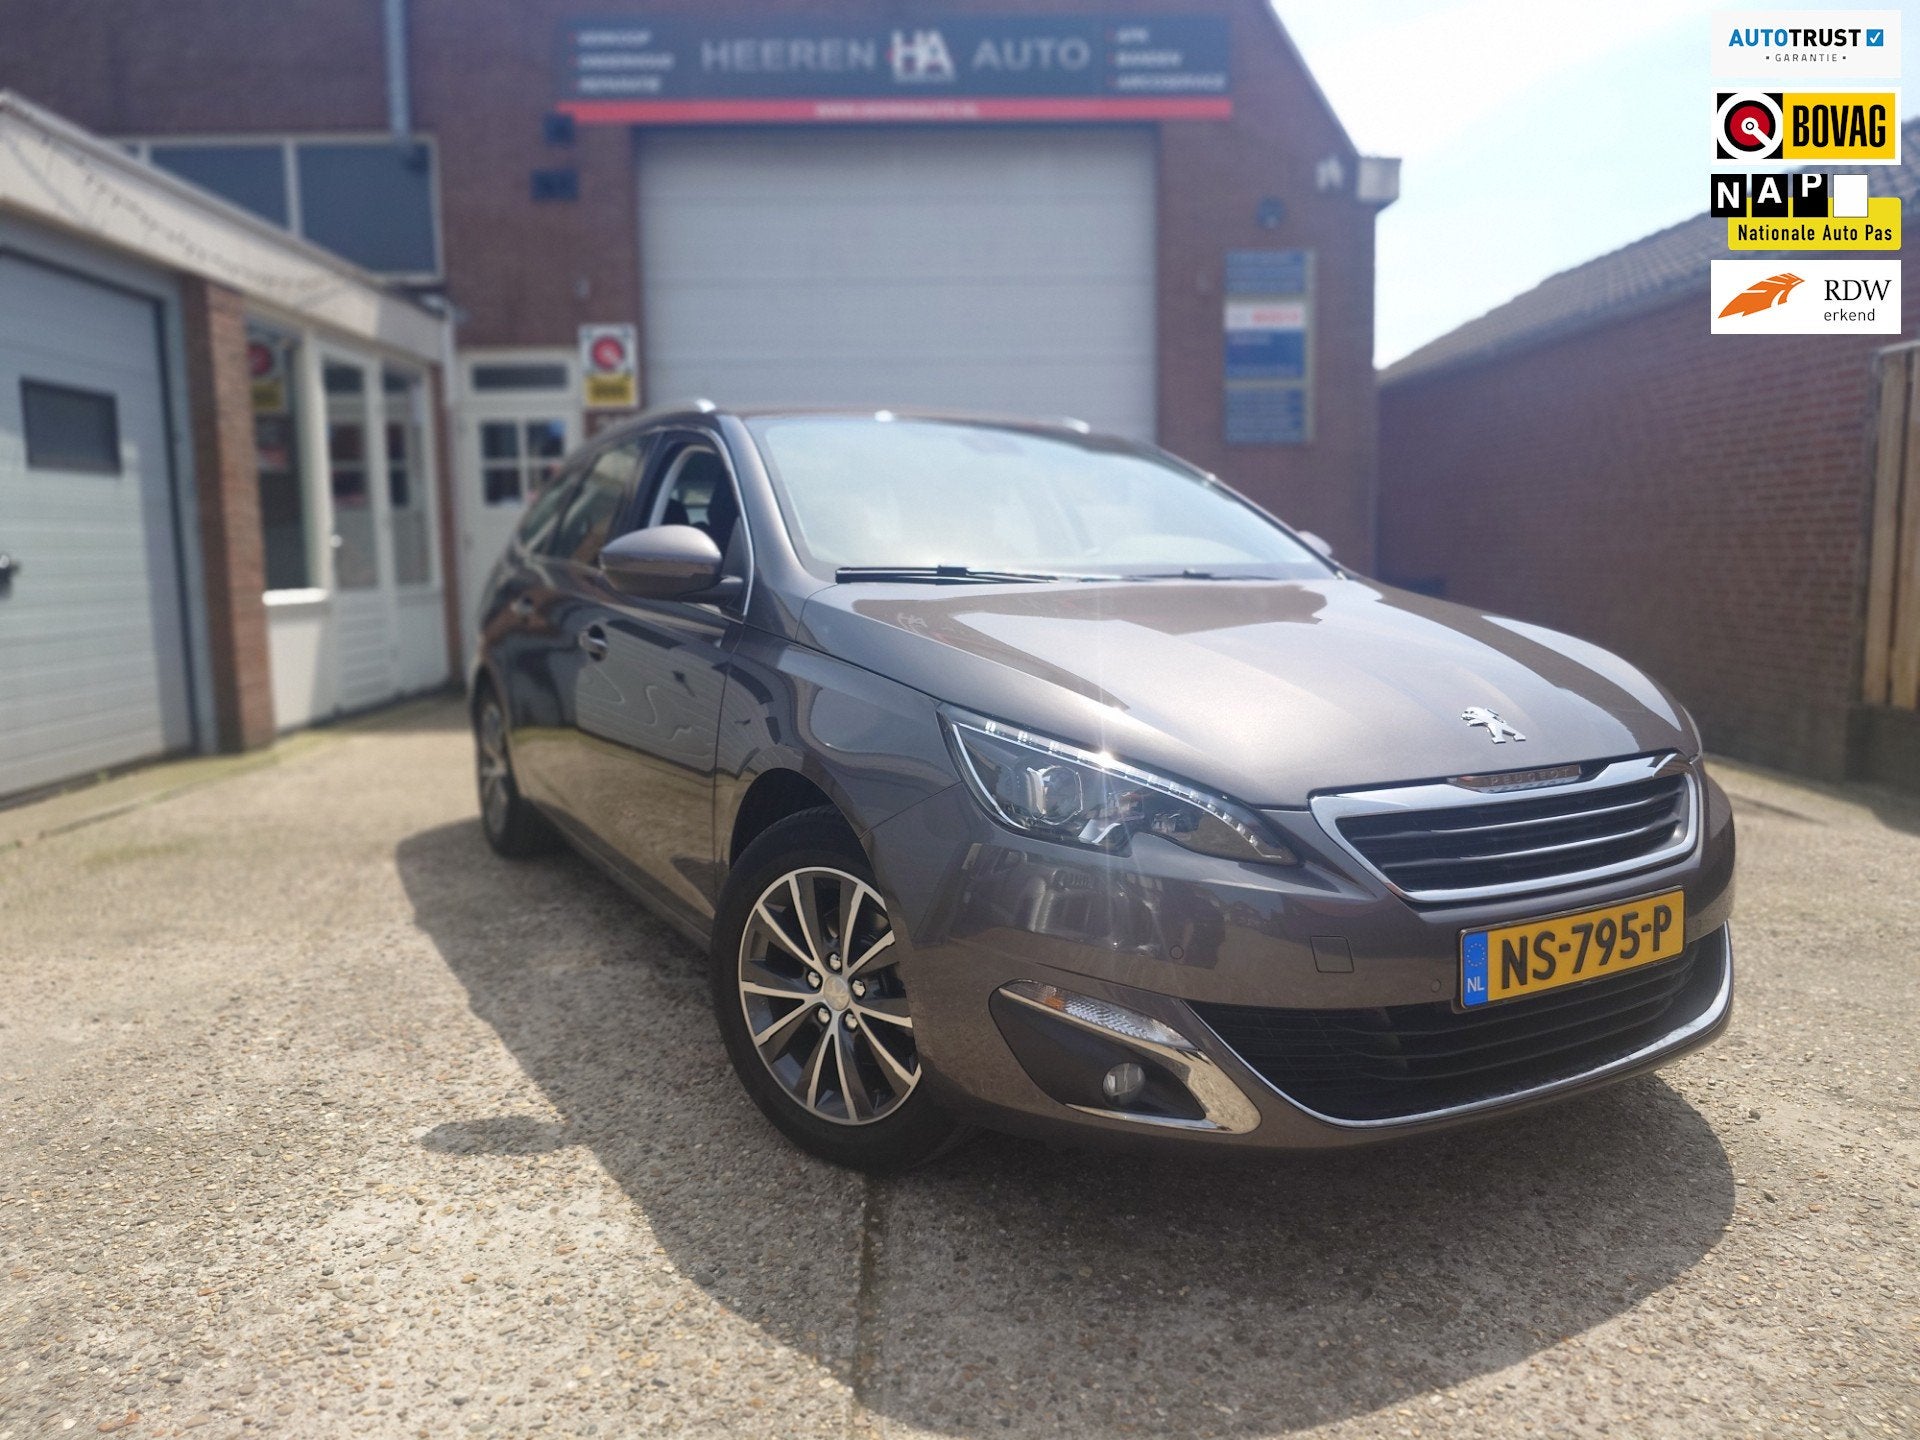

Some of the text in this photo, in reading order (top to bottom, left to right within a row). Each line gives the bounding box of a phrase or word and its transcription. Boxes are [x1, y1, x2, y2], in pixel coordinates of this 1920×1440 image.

[701, 38, 877, 72] HEEREN
[972, 38, 1092, 72] AUTO
[1501, 904, 1672, 990] NS-795-P
[1467, 976, 1485, 993] NL
